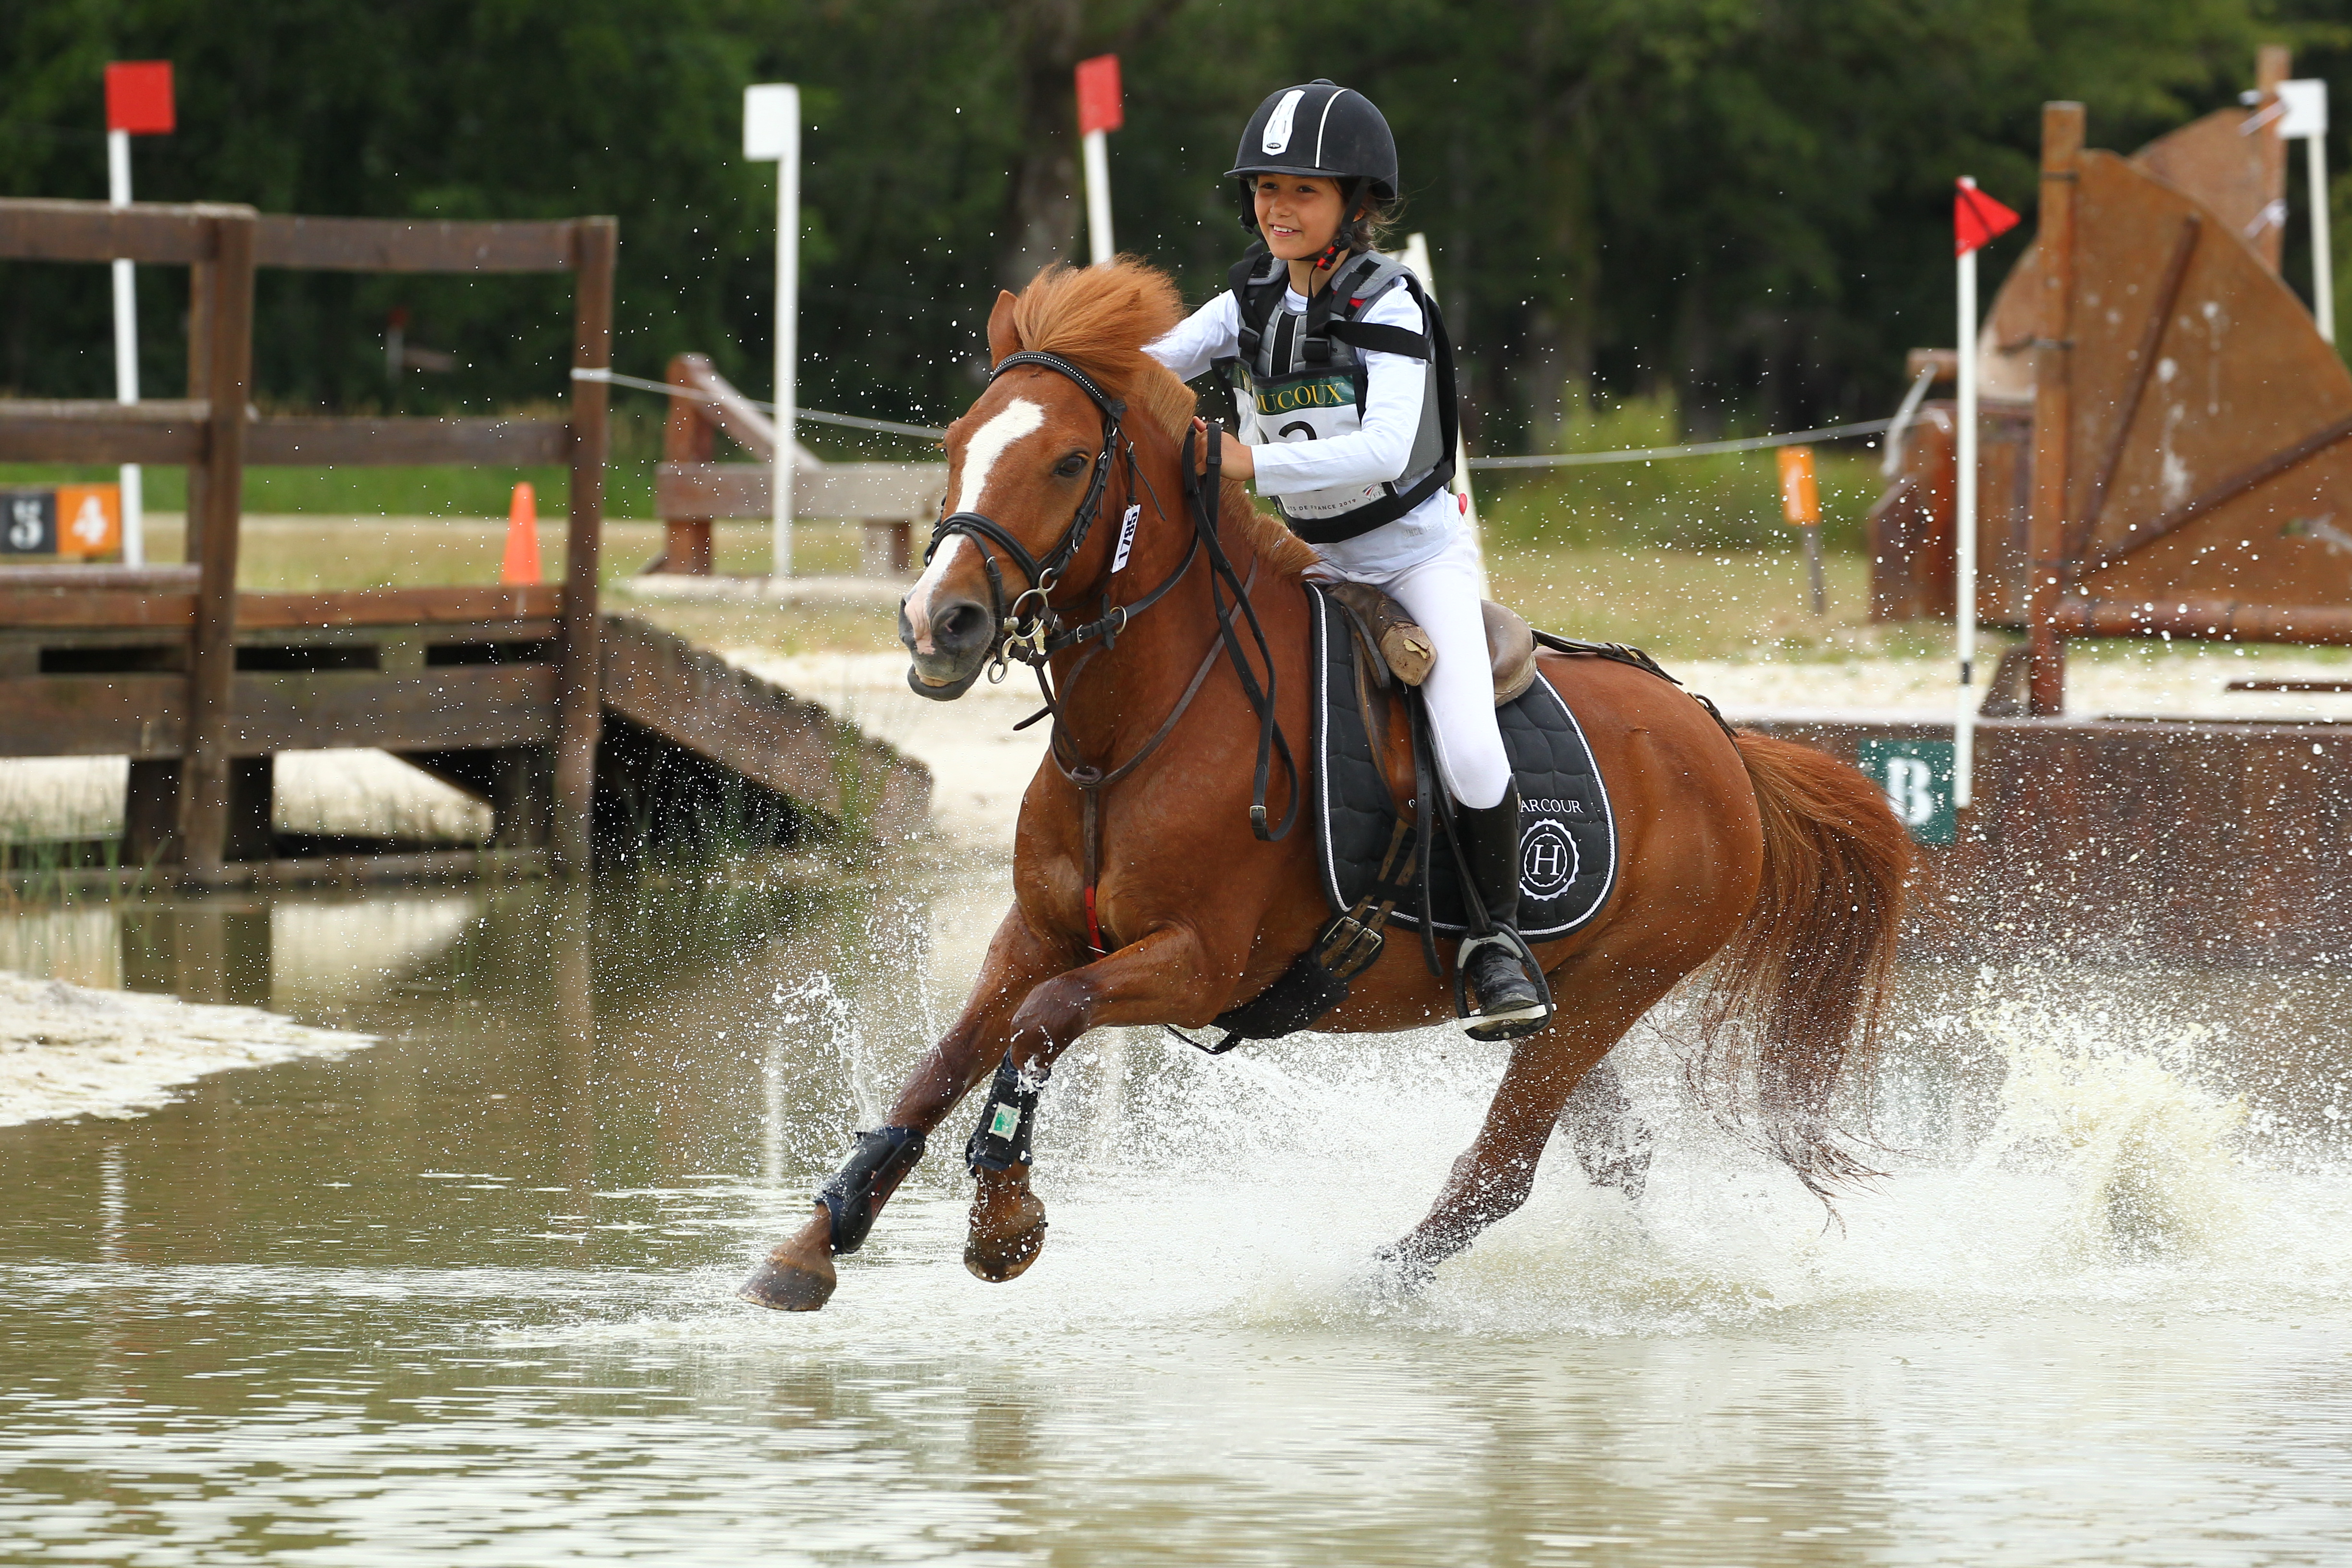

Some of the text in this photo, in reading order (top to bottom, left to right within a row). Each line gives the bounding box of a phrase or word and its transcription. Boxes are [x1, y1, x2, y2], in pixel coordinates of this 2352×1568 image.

[72, 495, 109, 546] 4
[1339, 498, 1356, 507] 2019
[9, 499, 44, 550] 5
[1118, 511, 1138, 563] 1785
[1520, 798, 1584, 813] ARCOUR
[1531, 844, 1562, 876] H
